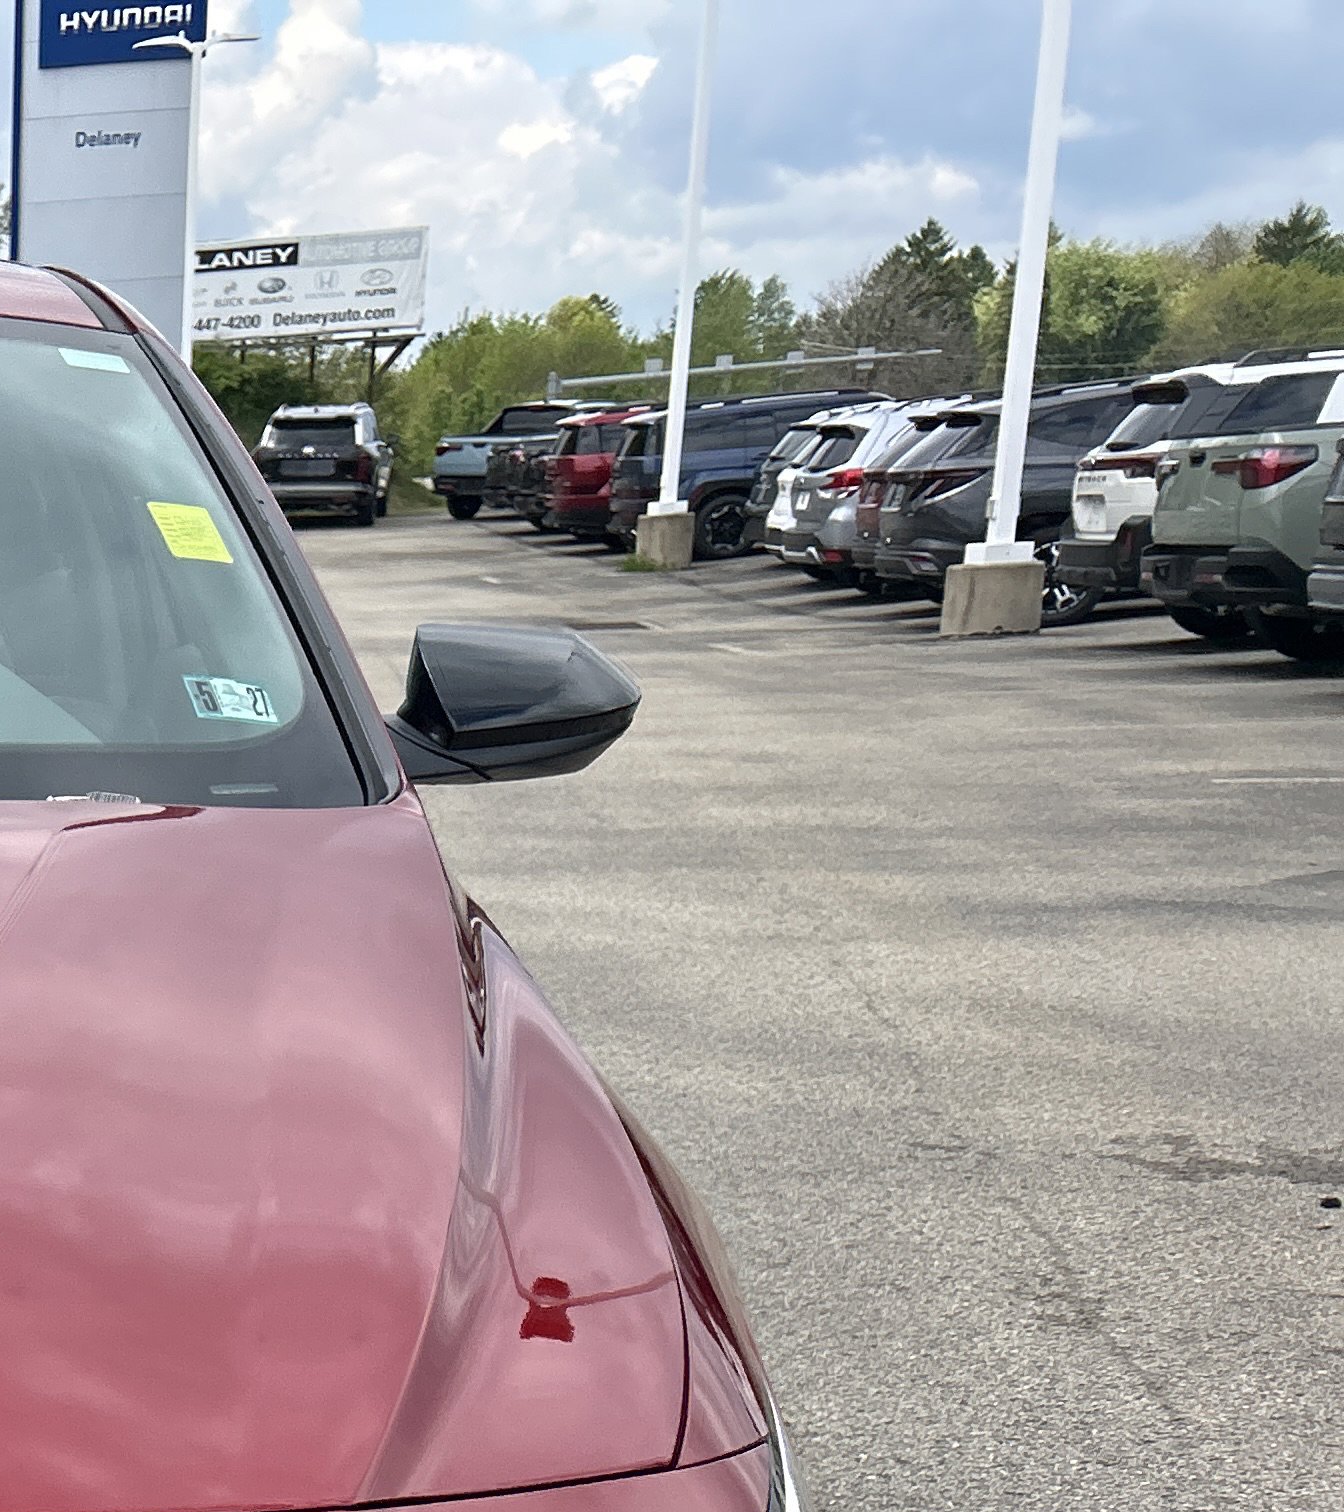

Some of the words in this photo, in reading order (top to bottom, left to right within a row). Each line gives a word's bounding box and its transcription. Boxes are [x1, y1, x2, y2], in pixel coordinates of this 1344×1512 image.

[59, 3, 193, 34] HYUNDAI
[74, 130, 142, 149] Delaney
[193, 313, 262, 331] 447-4200
[272, 306, 396, 327] Delaneyauto.com
[194, 680, 219, 712] 5
[245, 687, 270, 718] 27
